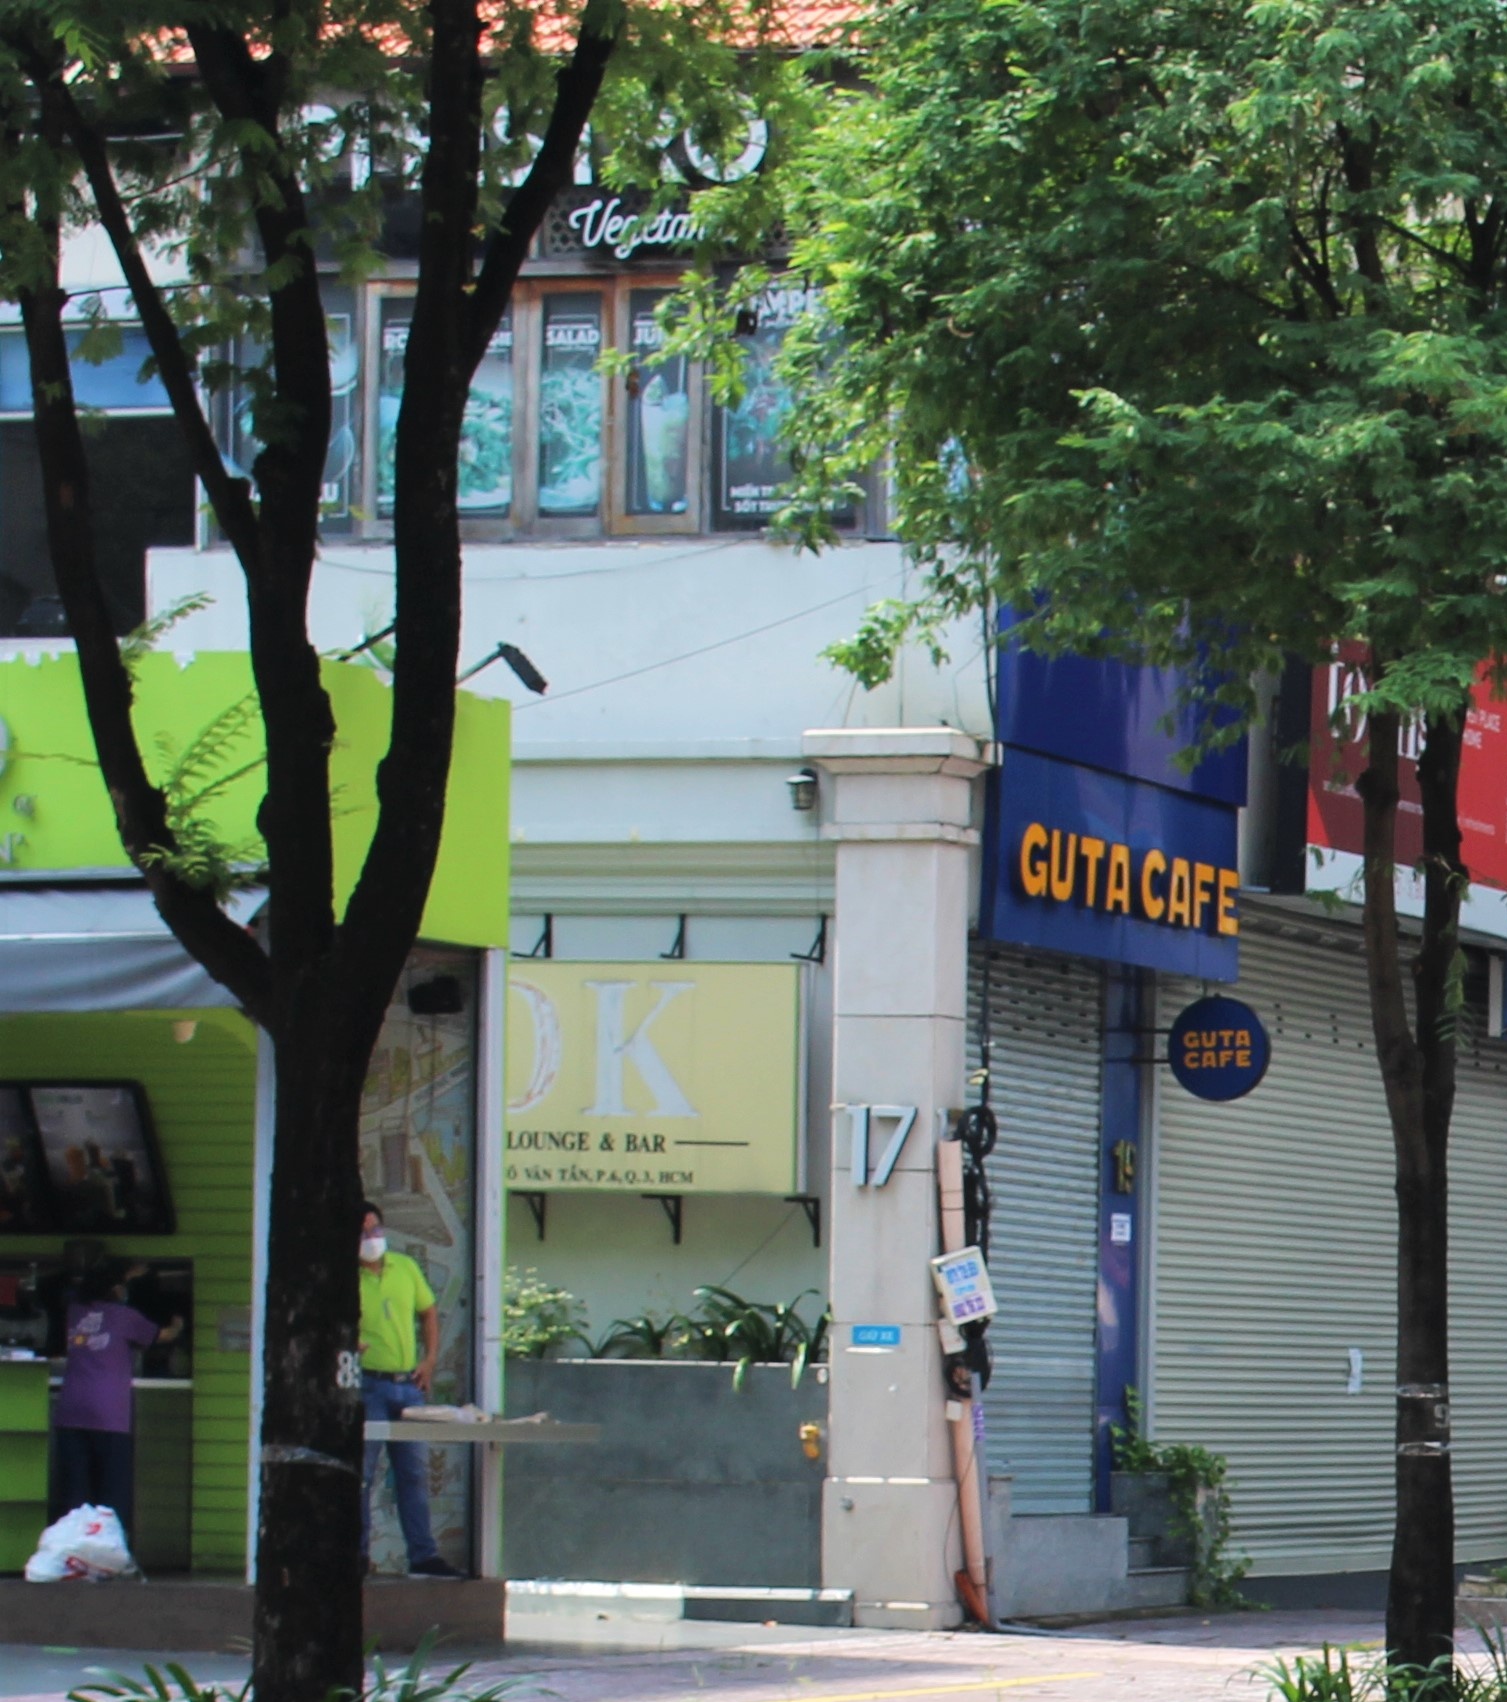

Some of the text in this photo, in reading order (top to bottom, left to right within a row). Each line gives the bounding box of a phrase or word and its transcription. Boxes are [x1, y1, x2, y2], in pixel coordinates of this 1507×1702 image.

[569, 198, 712, 259] Vegeta
[546, 329, 600, 346] SALAD
[1020, 822, 1239, 936] GUTA CAFE
[1183, 1029, 1251, 1048] GUTA
[1184, 1049, 1251, 1068] CAFE
[507, 1131, 667, 1153] LOUNGE & BAR
[843, 1105, 917, 1189] 17
[658, 1171, 694, 1184] HCM
